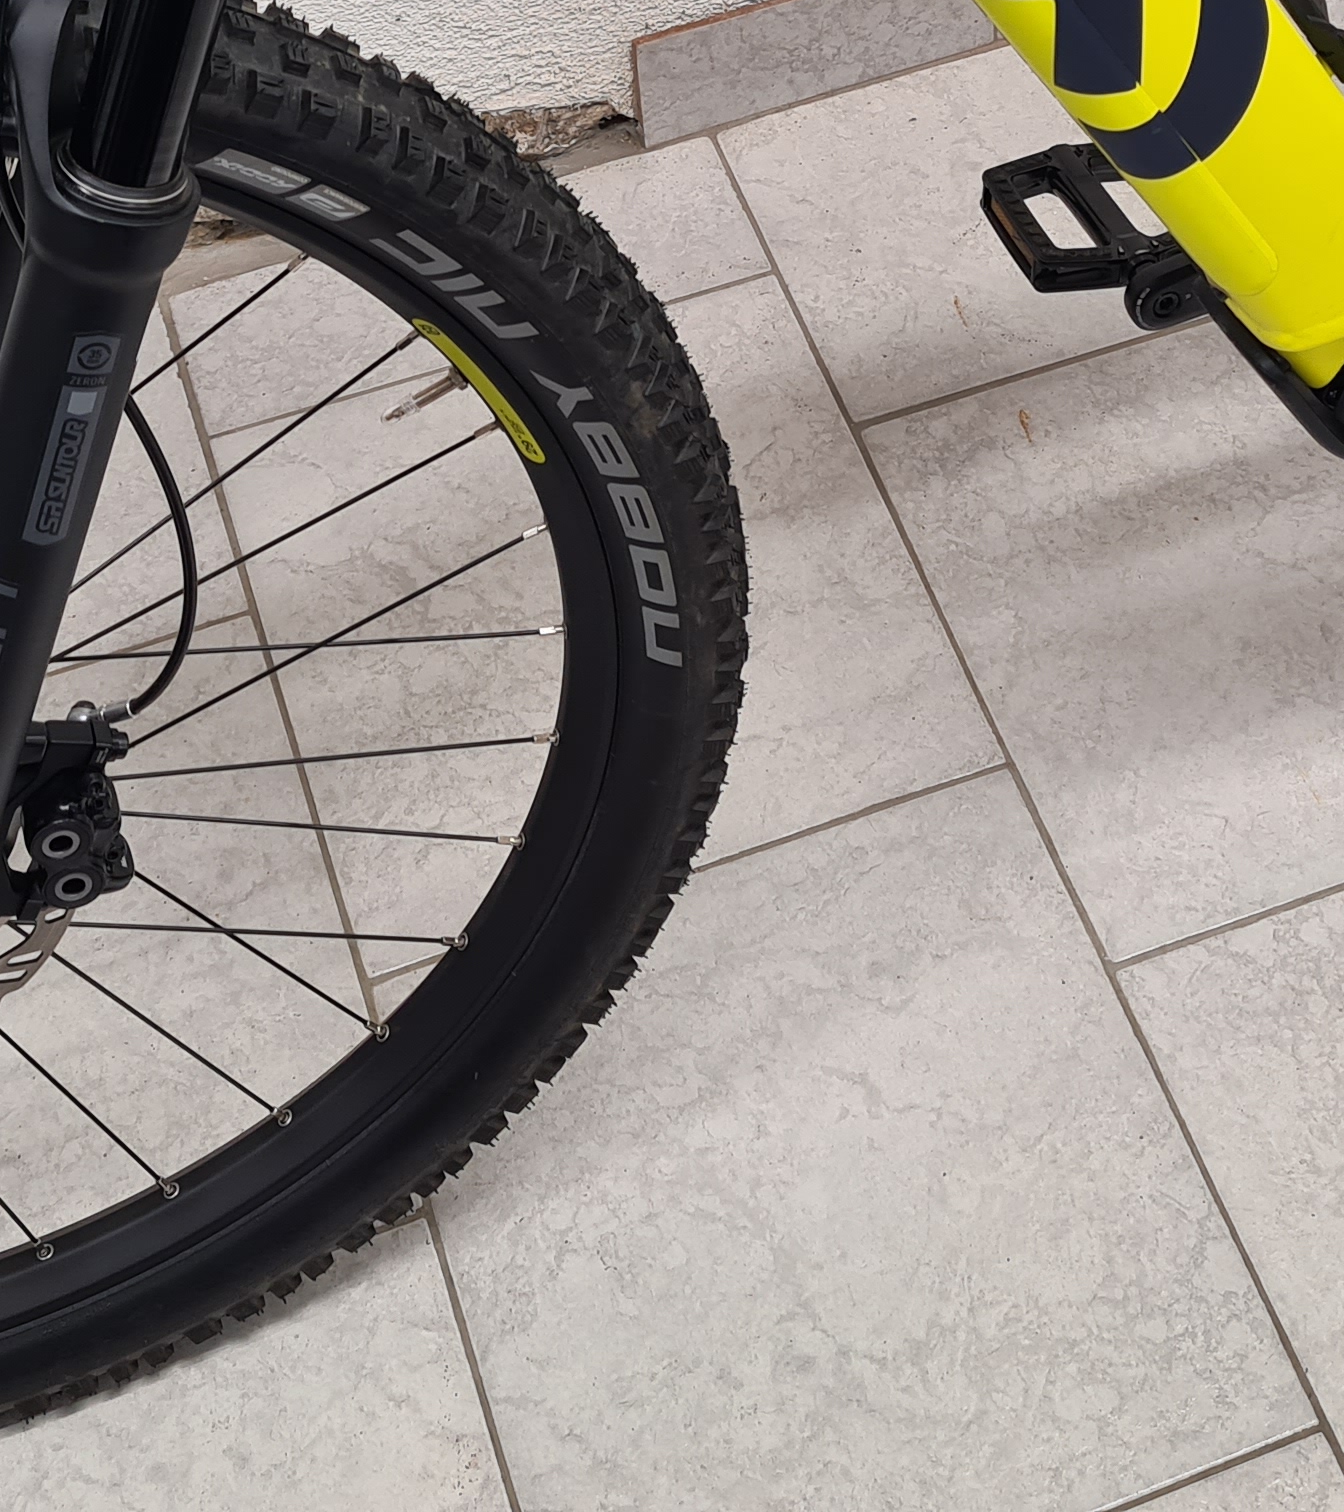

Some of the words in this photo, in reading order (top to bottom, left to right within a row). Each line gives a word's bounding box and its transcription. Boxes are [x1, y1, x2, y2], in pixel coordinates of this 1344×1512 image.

[370, 229, 540, 340] NIC
[68, 373, 107, 386] ZERON
[45, 418, 88, 502] SUNTOUR
[529, 368, 683, 668] NOBBY
